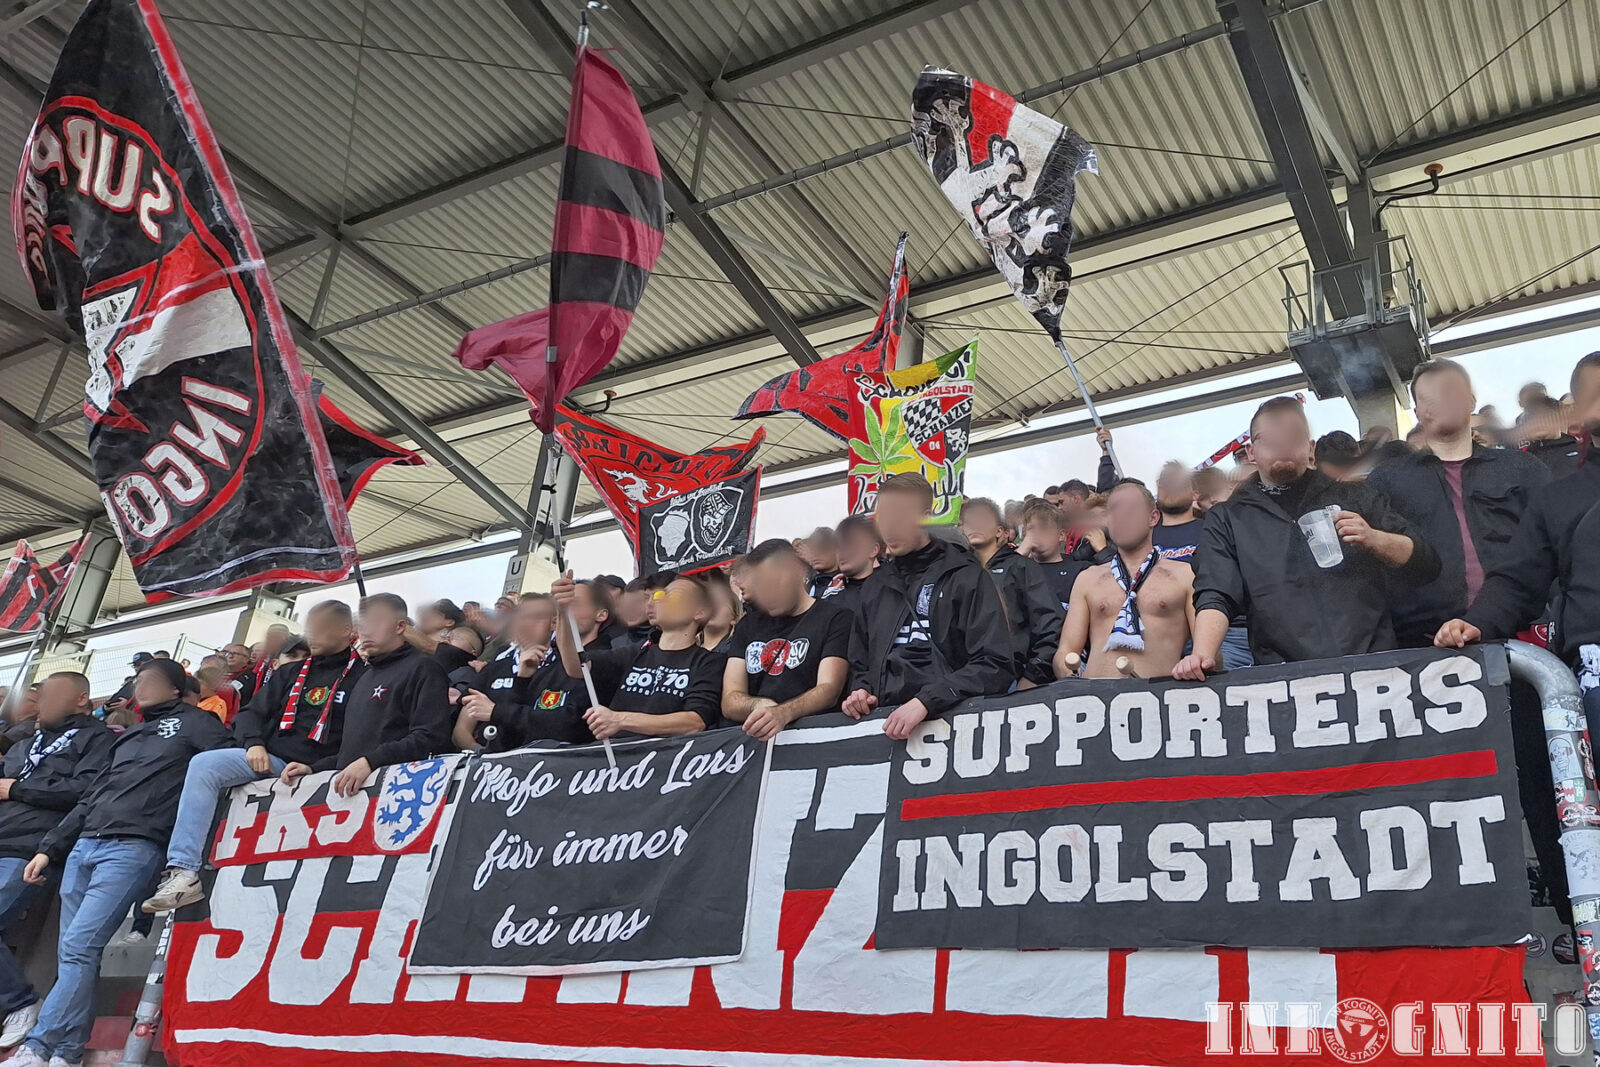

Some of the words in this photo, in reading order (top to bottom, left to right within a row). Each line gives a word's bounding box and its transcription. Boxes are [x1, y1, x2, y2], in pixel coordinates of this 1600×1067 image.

[903, 656, 1488, 784] SUPPORTERS
[214, 767, 381, 857] FKS
[471, 761, 561, 817] Mofo
[568, 750, 657, 796] und
[660, 739, 755, 795] Lars
[472, 828, 544, 892] für
[551, 824, 689, 868] immer
[892, 795, 1506, 913] INGOLSTADT
[491, 904, 561, 949] bei
[566, 908, 651, 946] uns
